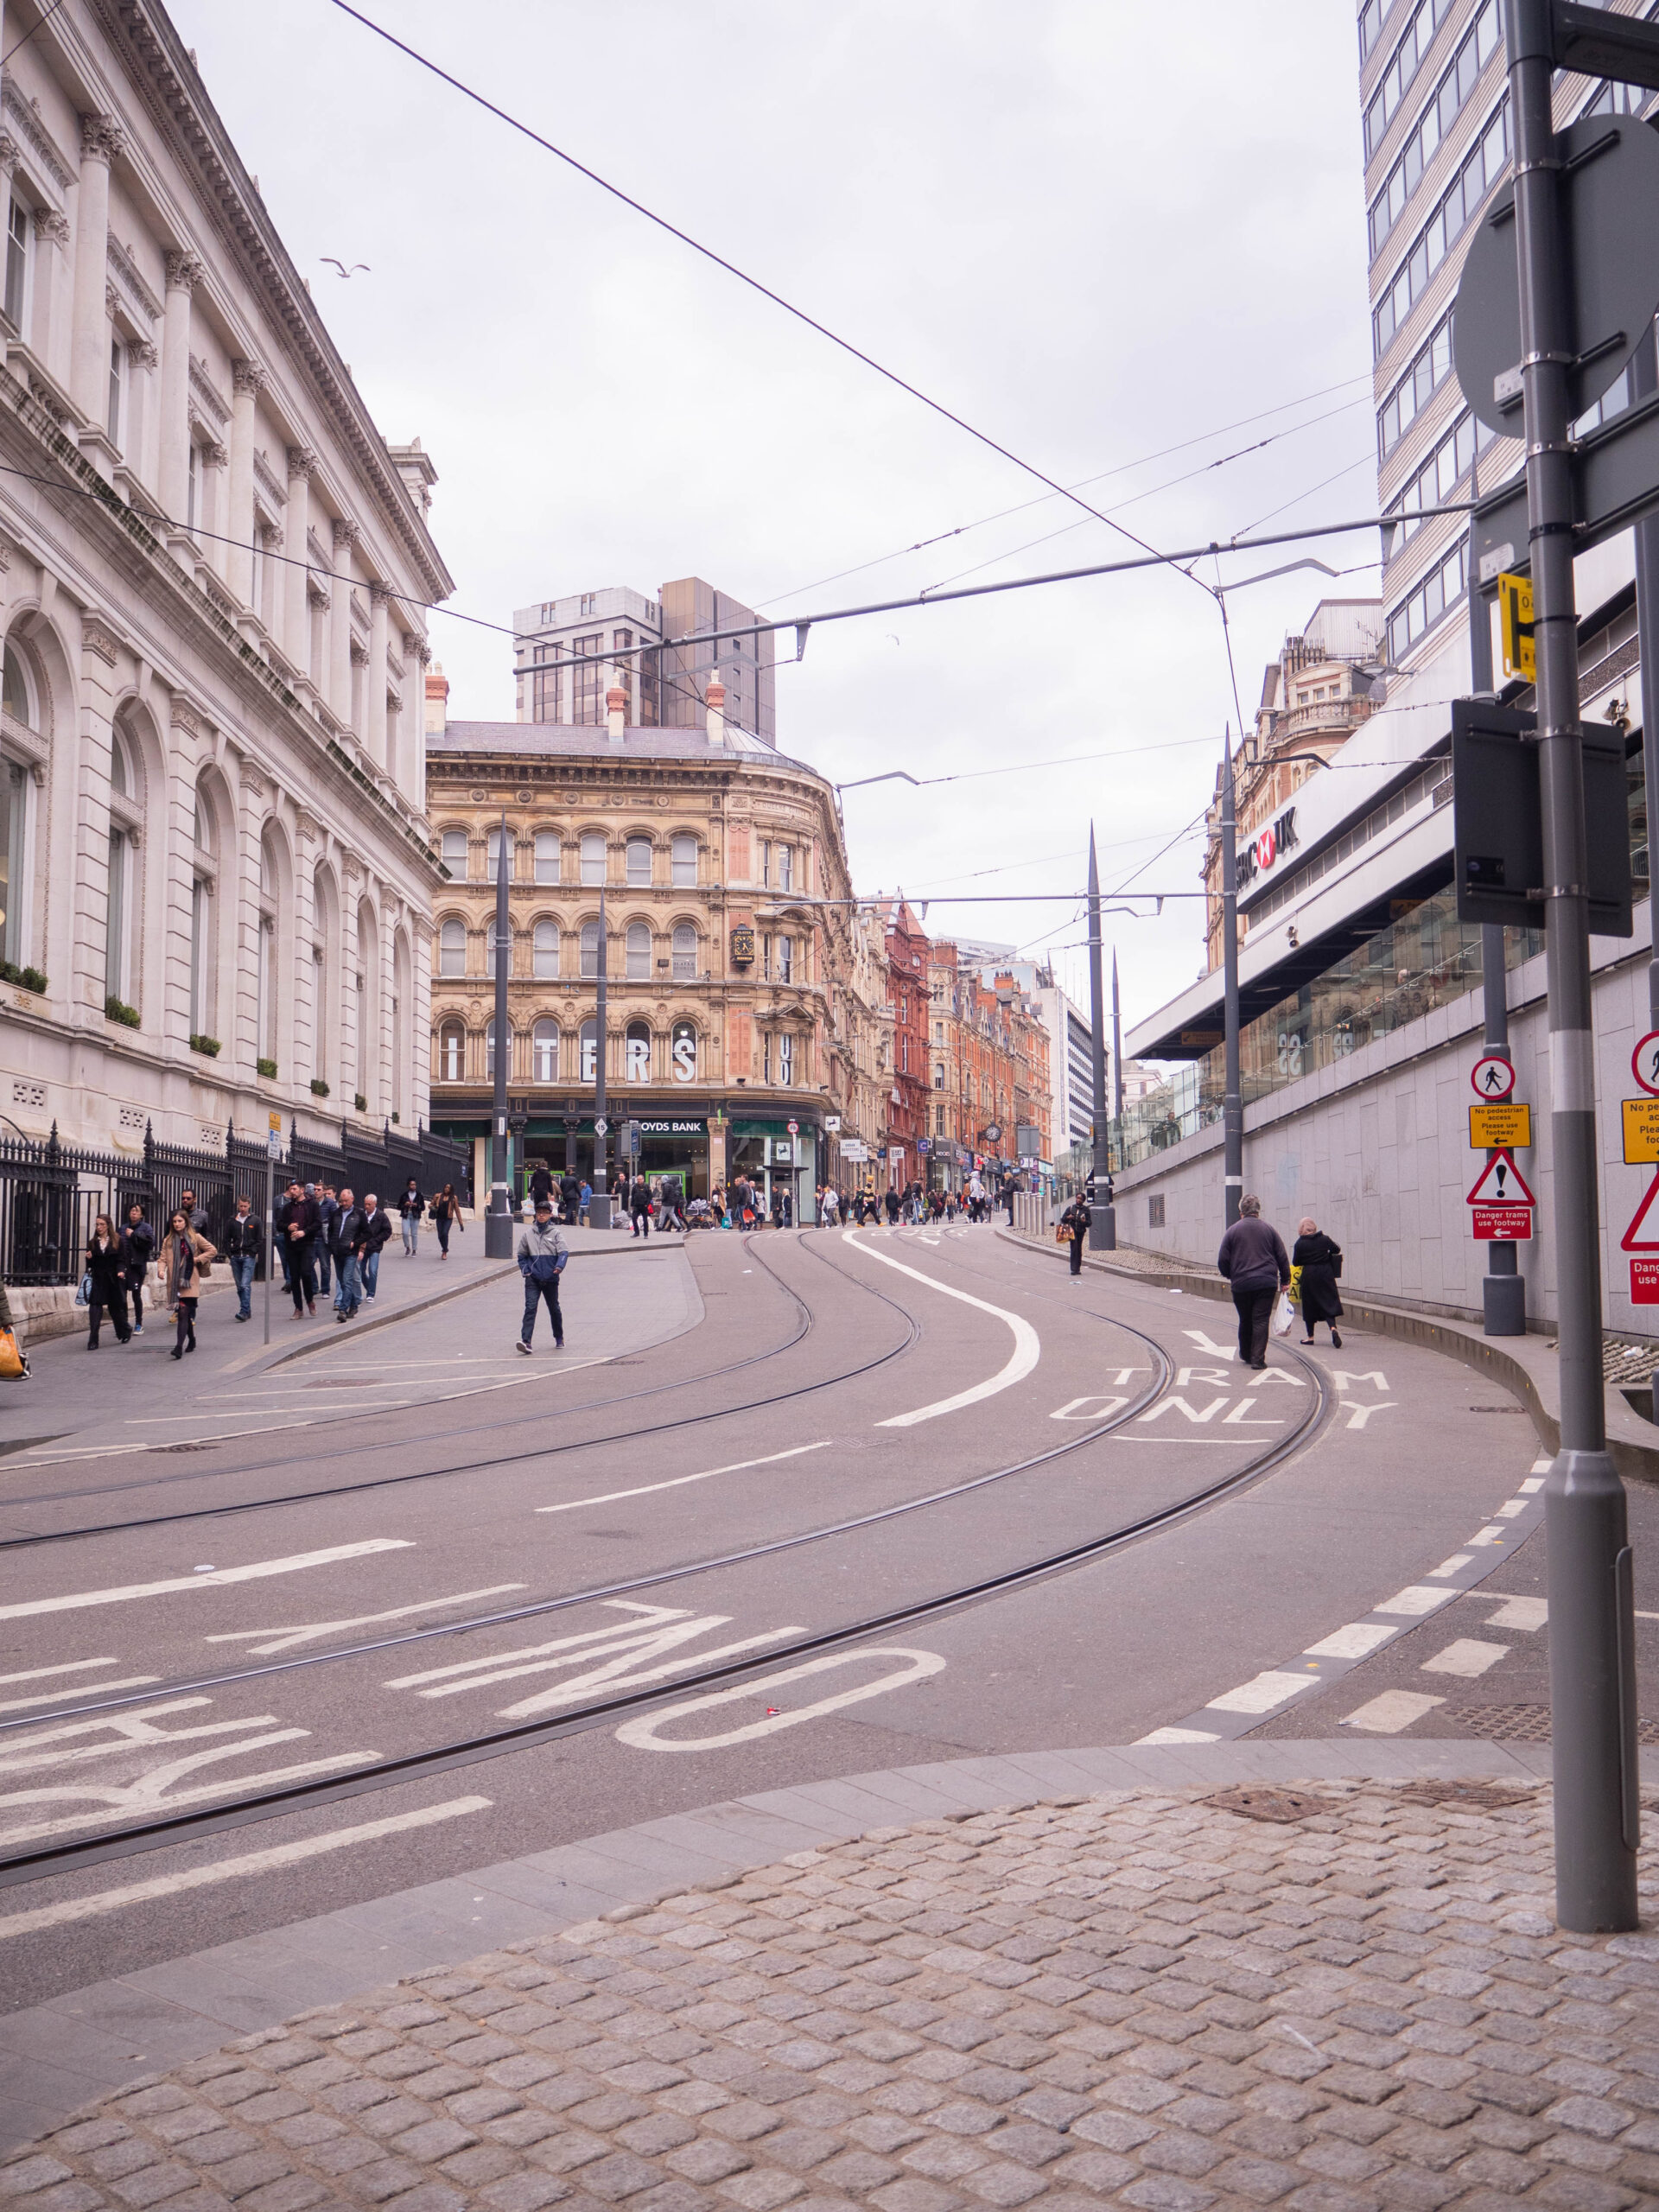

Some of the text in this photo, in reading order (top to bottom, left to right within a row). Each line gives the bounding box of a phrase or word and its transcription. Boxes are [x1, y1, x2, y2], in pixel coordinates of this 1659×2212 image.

[1273, 806, 1299, 854] UK
[1630, 1103, 1644, 1112] No
[640, 1122, 702, 1131] OYDS BANK
[1475, 1211, 1503, 1220] Danger
[1106, 1367, 1390, 1390] TRAM
[1049, 1395, 1400, 1429] ONLY
